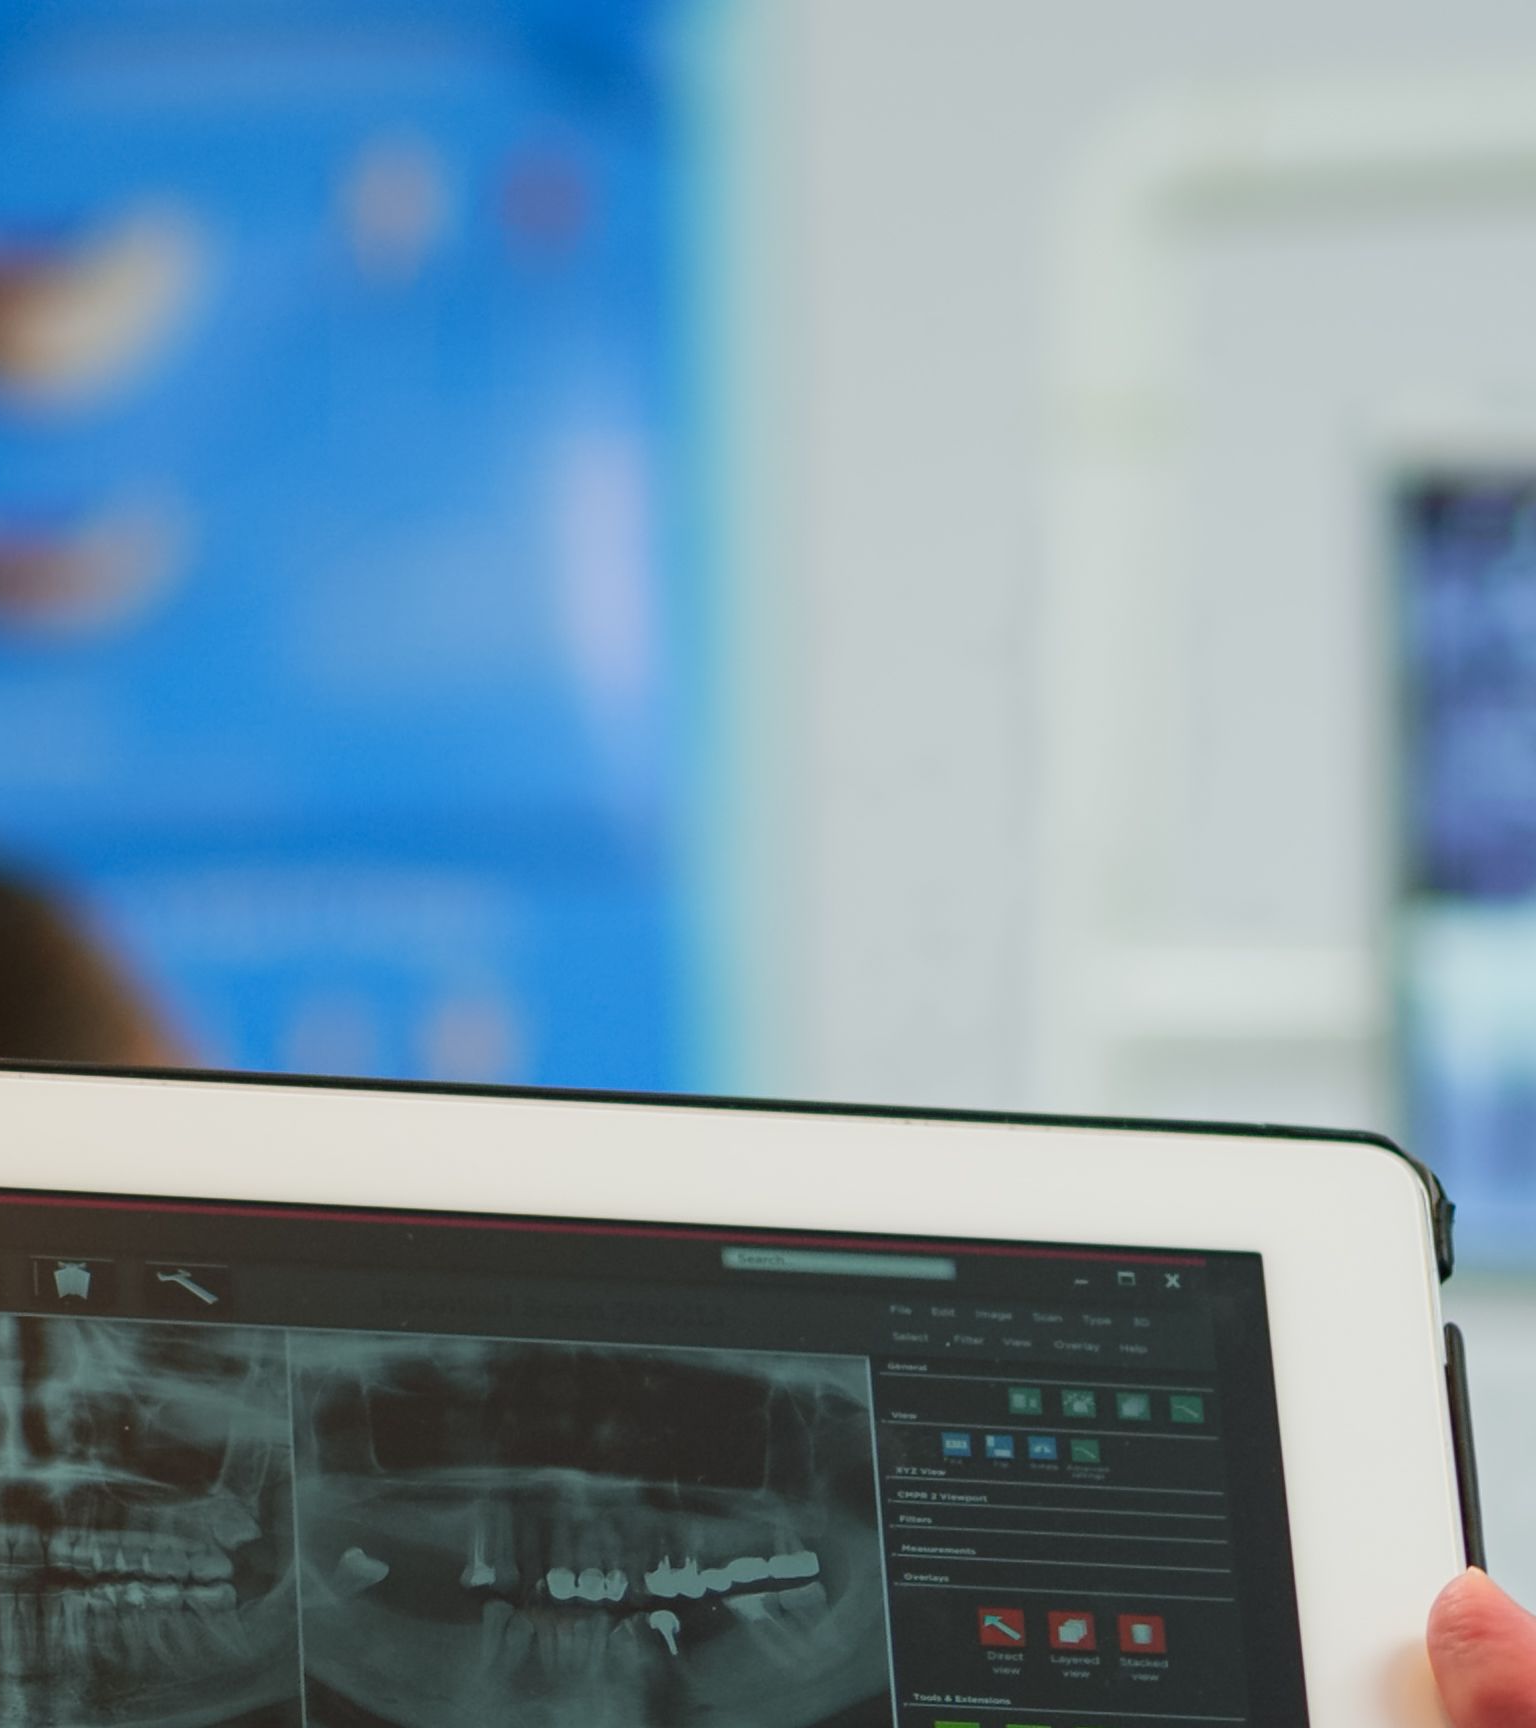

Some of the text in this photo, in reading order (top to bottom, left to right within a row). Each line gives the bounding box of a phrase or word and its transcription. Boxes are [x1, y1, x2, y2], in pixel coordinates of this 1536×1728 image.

[890, 1304, 913, 1315] File
[931, 1306, 956, 1317] Edit
[975, 1309, 1013, 1322] Image
[1082, 1314, 1112, 1326] Type
[892, 1331, 929, 1342] Select
[1053, 1339, 1101, 1352] Overlay
[887, 1361, 928, 1371] General
[891, 1411, 917, 1420] View
[921, 1467, 946, 1477] View
[940, 1492, 987, 1503] Viewport
[899, 1515, 933, 1524] Filters
[901, 1544, 977, 1555] Measurements
[903, 1572, 950, 1583] Overlays
[987, 1650, 1024, 1661] Direct
[1050, 1654, 1100, 1666] Layered
[1120, 1657, 1169, 1668] Stacked
[992, 1667, 1021, 1676] view
[1062, 1669, 1090, 1679] view
[913, 1693, 1011, 1705] Tools & Extensions
